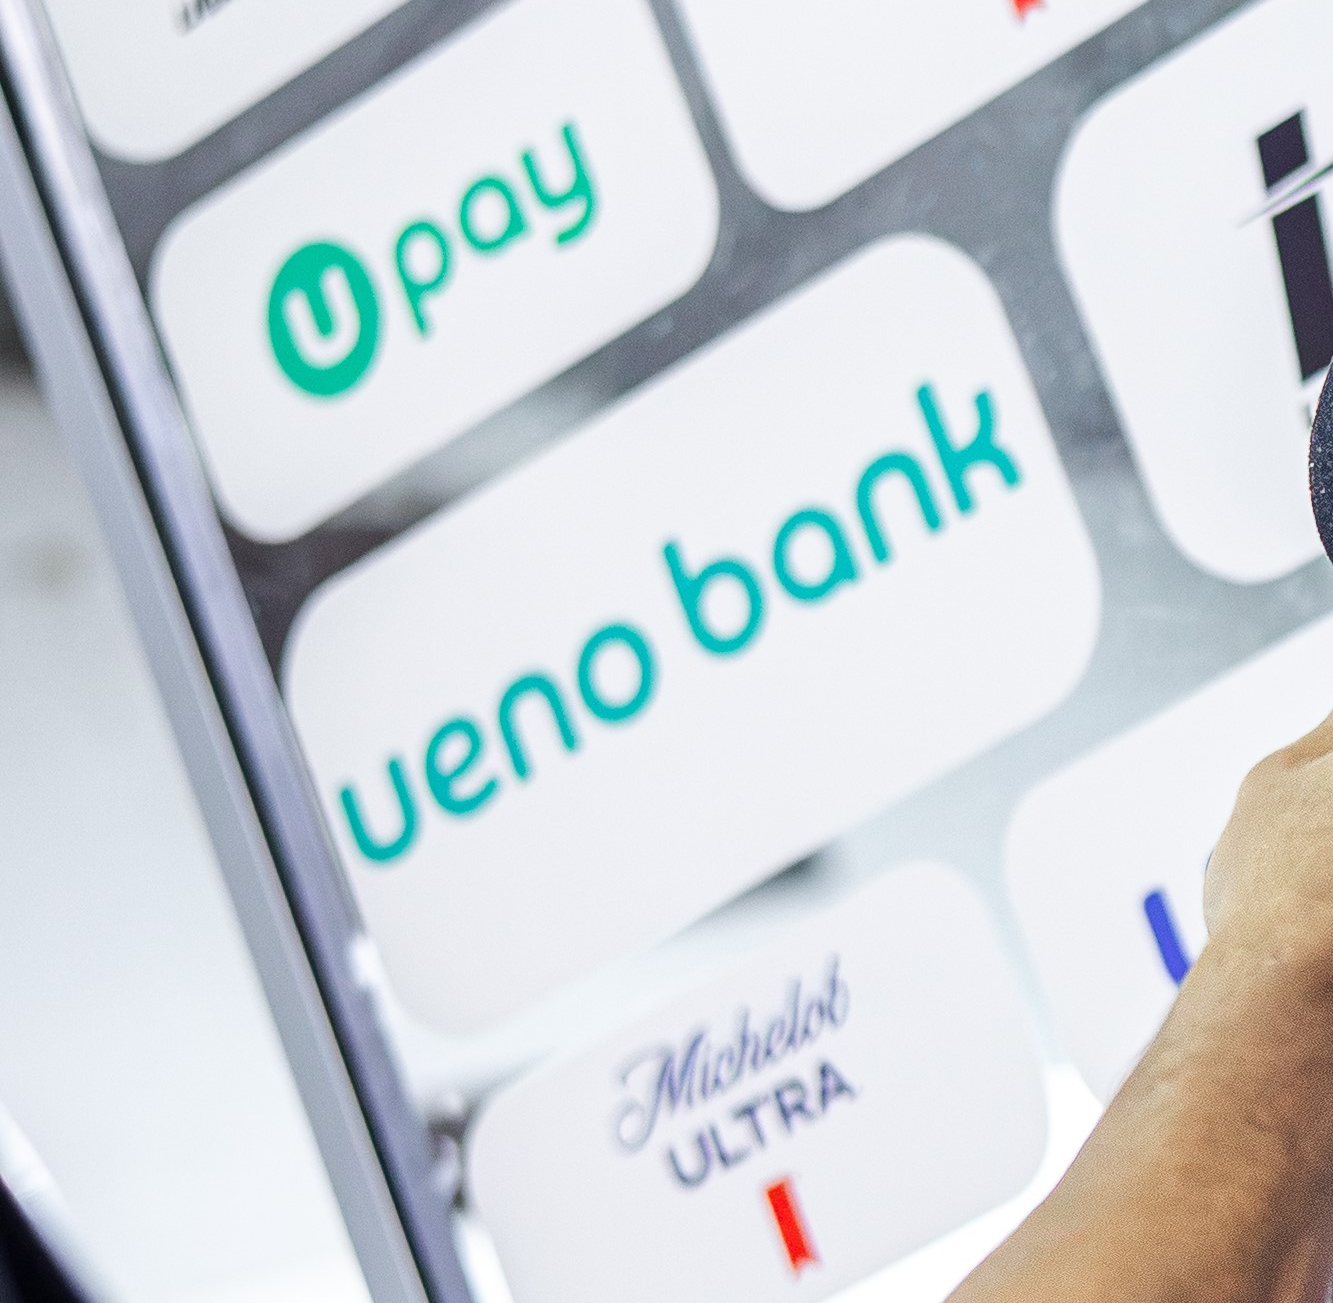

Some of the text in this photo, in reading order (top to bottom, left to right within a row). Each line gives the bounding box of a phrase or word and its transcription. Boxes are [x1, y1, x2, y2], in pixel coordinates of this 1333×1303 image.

[338, 382, 1023, 866] ueno bank
[664, 1058, 858, 1190] ULTRA
